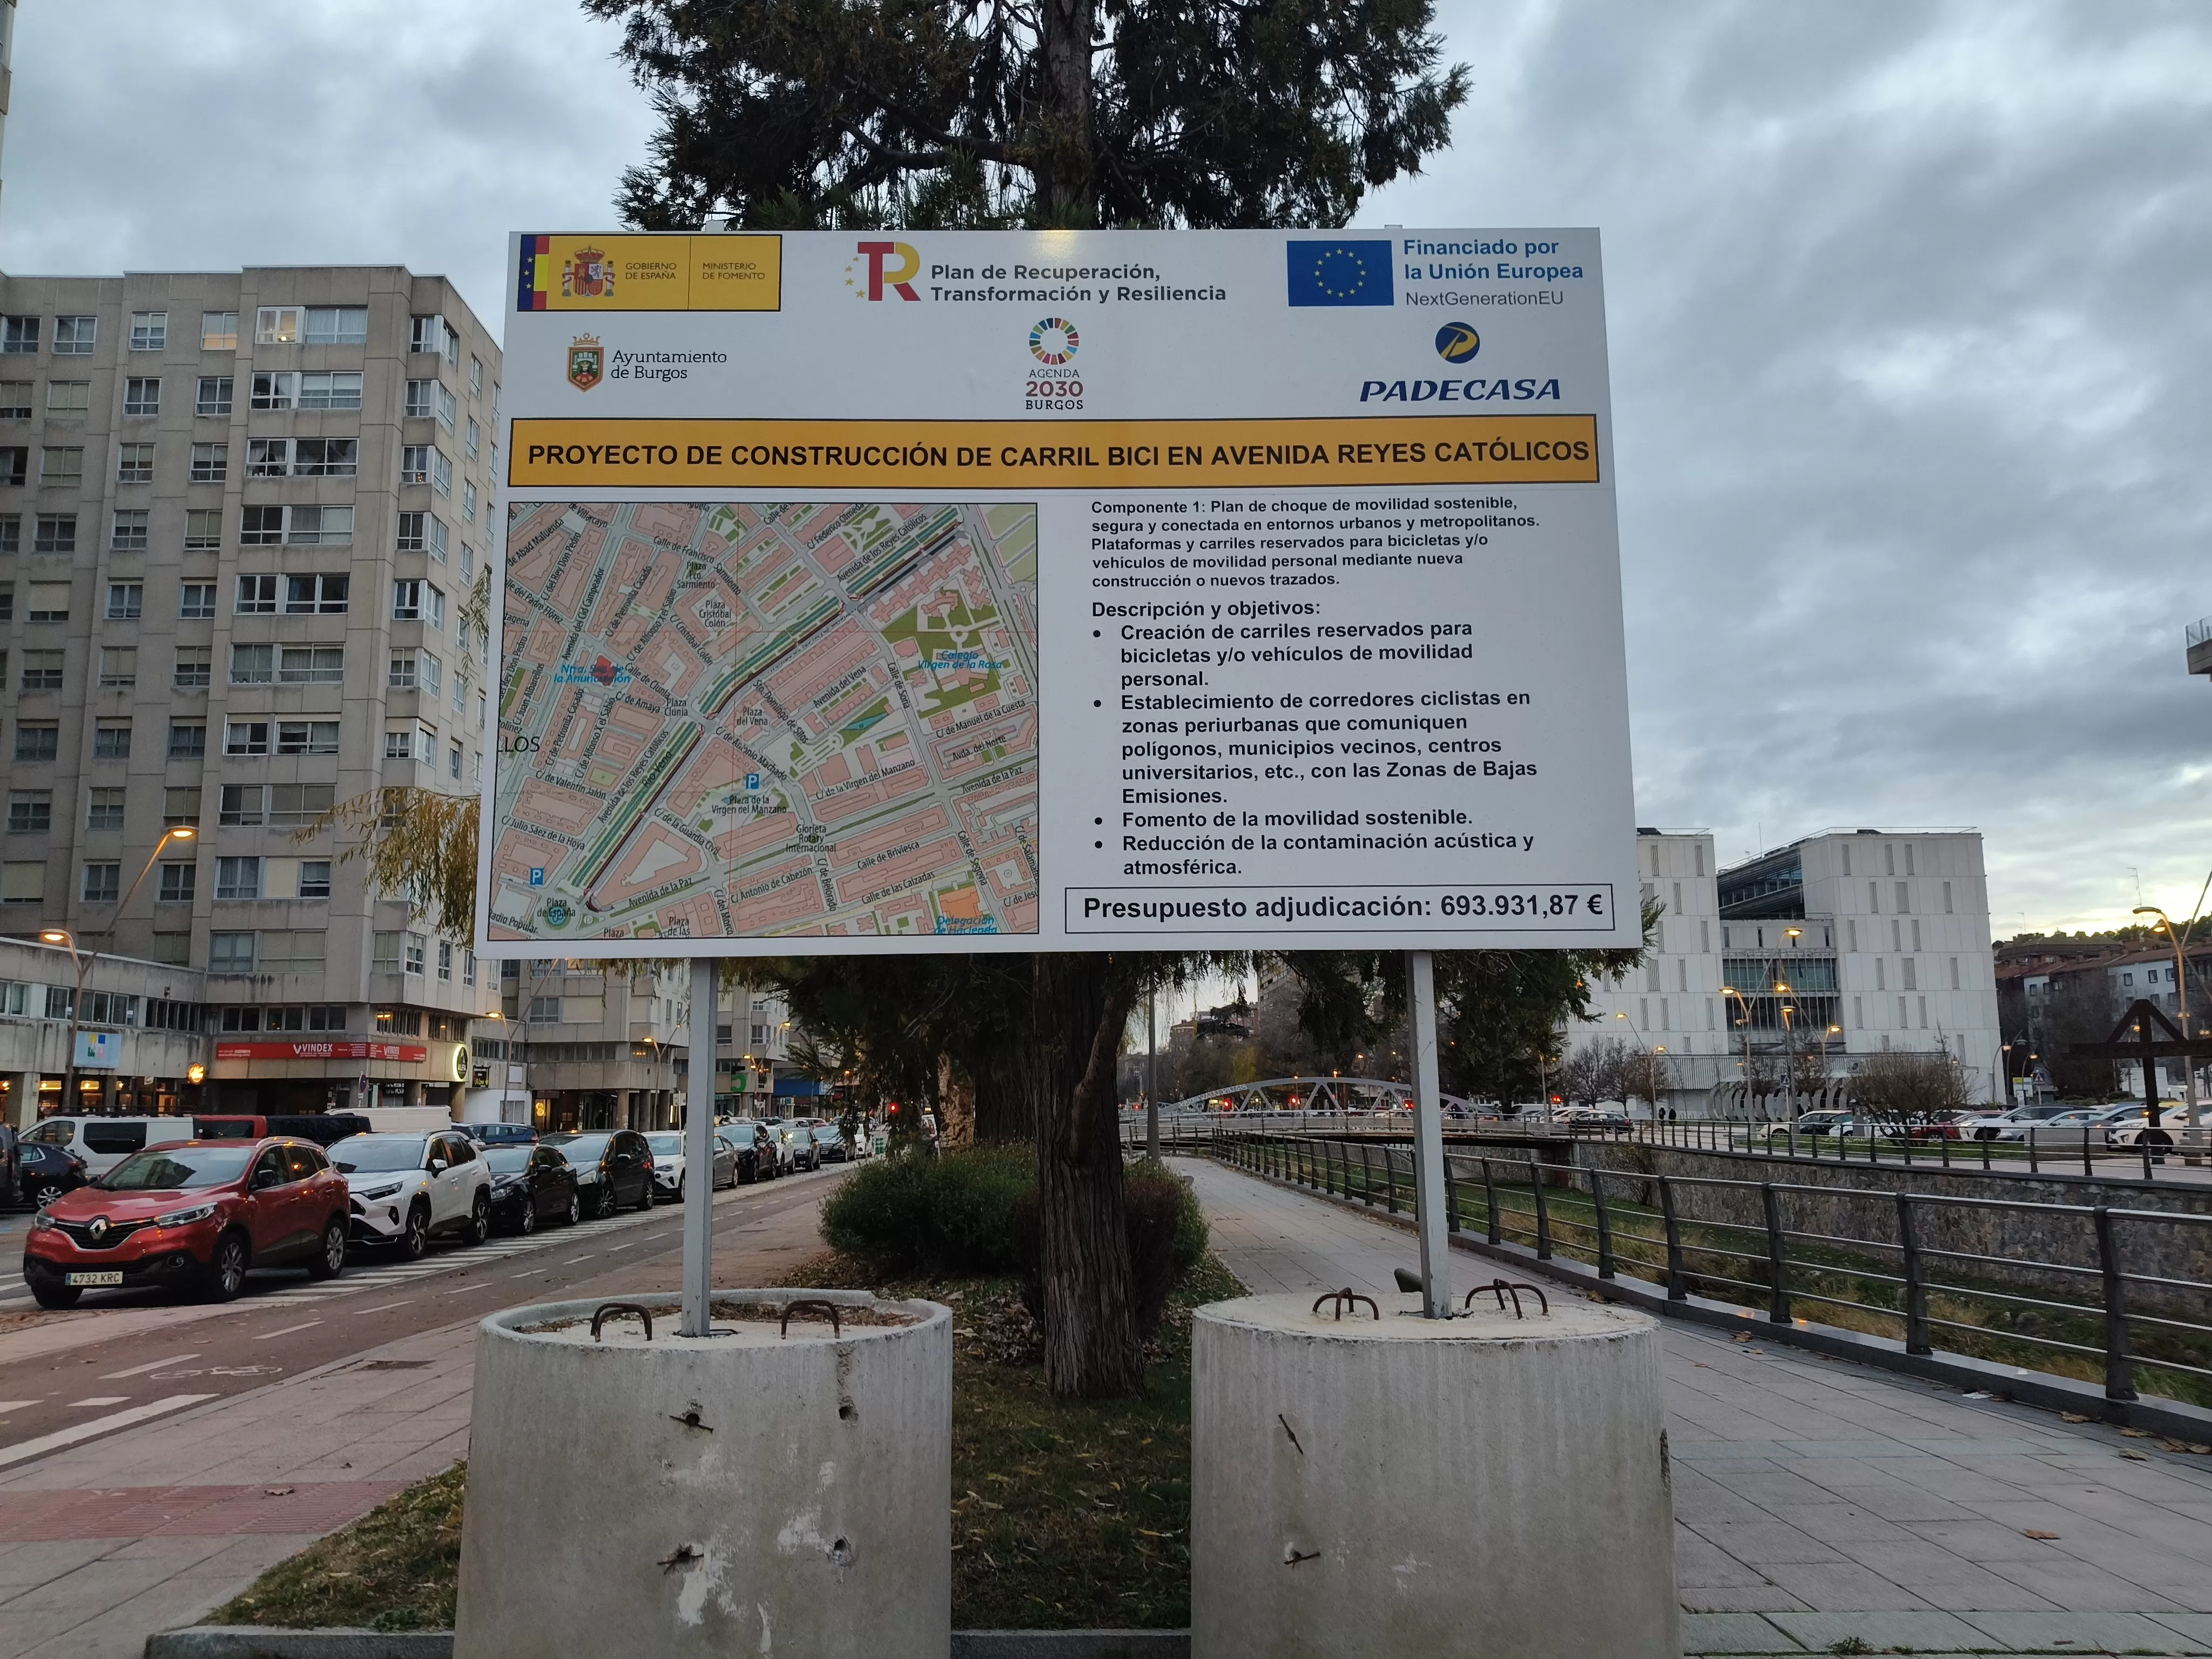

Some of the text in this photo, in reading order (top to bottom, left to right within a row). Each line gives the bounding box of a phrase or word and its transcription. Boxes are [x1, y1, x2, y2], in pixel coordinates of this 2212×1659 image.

[1404, 239, 1559, 258] Financiado por
[625, 262, 677, 271] GOBIERNO
[703, 262, 757, 271] MINISTERIO
[932, 263, 1160, 282] Plan de Recuperación,
[1405, 263, 1583, 282] la Unión Europea
[625, 270, 677, 280] DE ESPAÑA
[702, 272, 766, 280] DE FOMENTO
[930, 285, 1226, 304] Transformación y Resiliencia
[1406, 291, 1563, 306] NextGenerationEU
[611, 349, 727, 367] Ayuntamiento
[610, 365, 687, 382] de Burgos
[1028, 368, 1080, 379] AGENDA
[1025, 380, 1083, 397] 2030
[1359, 379, 1560, 402] PADECASA
[1026, 400, 1083, 411] BURGOS
[529, 436, 1589, 467] PROYECTO DE CONSTRUCCIÓN DE CARRIL BICI EN AVENIDA REYES CATÓLICOS
[1091, 496, 1517, 516] Componente 1: Plan de choque de movilidad sostenible,
[1092, 515, 1540, 535] segura y conectada en entornos urbanos y metropolitanos.
[1091, 533, 1488, 553] Plataformas y carriles reservados para bicicletas y/o
[1092, 553, 1463, 570] vehículos de movilidad personal mediante nueva
[1092, 572, 1339, 588] construcción o nuevos trazados.
[706, 599, 725, 609] Plaza
[1092, 600, 1320, 621] Descripción y objetivos:
[699, 609, 732, 618] Cristóbal
[705, 618, 725, 628] Colón
[1121, 621, 1472, 640] Creación de carriles reservados para
[941, 650, 979, 662] Colegio
[1121, 643, 1473, 666] bicicletas y/o vehículos de movilidad
[918, 659, 1002, 670] Virgen de la Rosa
[1122, 671, 1209, 690] personal.
[667, 698, 686, 707] Plaza
[1122, 690, 1530, 710] Establecimiento de corredores ciclistas en
[664, 707, 688, 717] Clunia
[742, 706, 762, 716] Plaza
[737, 716, 768, 726] del Vena
[1122, 714, 1467, 737] zonas periurbanas que comuniquen
[1122, 738, 1502, 760] polígonos, municipios vecinos, centros
[1122, 760, 1537, 781] universitarios, etc., con las Zonas de Bajas
[730, 794, 770, 804] Plaza de la
[1123, 788, 1227, 804] Emisiones.
[711, 804, 787, 816] Virgen del Manzano
[1123, 809, 1472, 827] Fomento de la movilidad sostenible.
[796, 824, 826, 833] Glorieta
[799, 833, 824, 844] Rotary
[1123, 832, 1534, 852] Reducción de la contaminación acústica y
[786, 843, 837, 853] Internacional
[1123, 859, 1242, 875] atmosférica.
[731, 867, 813, 903] C/ Antonio de Cabezón
[1084, 894, 1603, 923] Presupuesto adjudicación: 693.931,87 €
[302, 1043, 333, 1052] VINDEX
[72, 1273, 119, 1283] 4732 KRC
